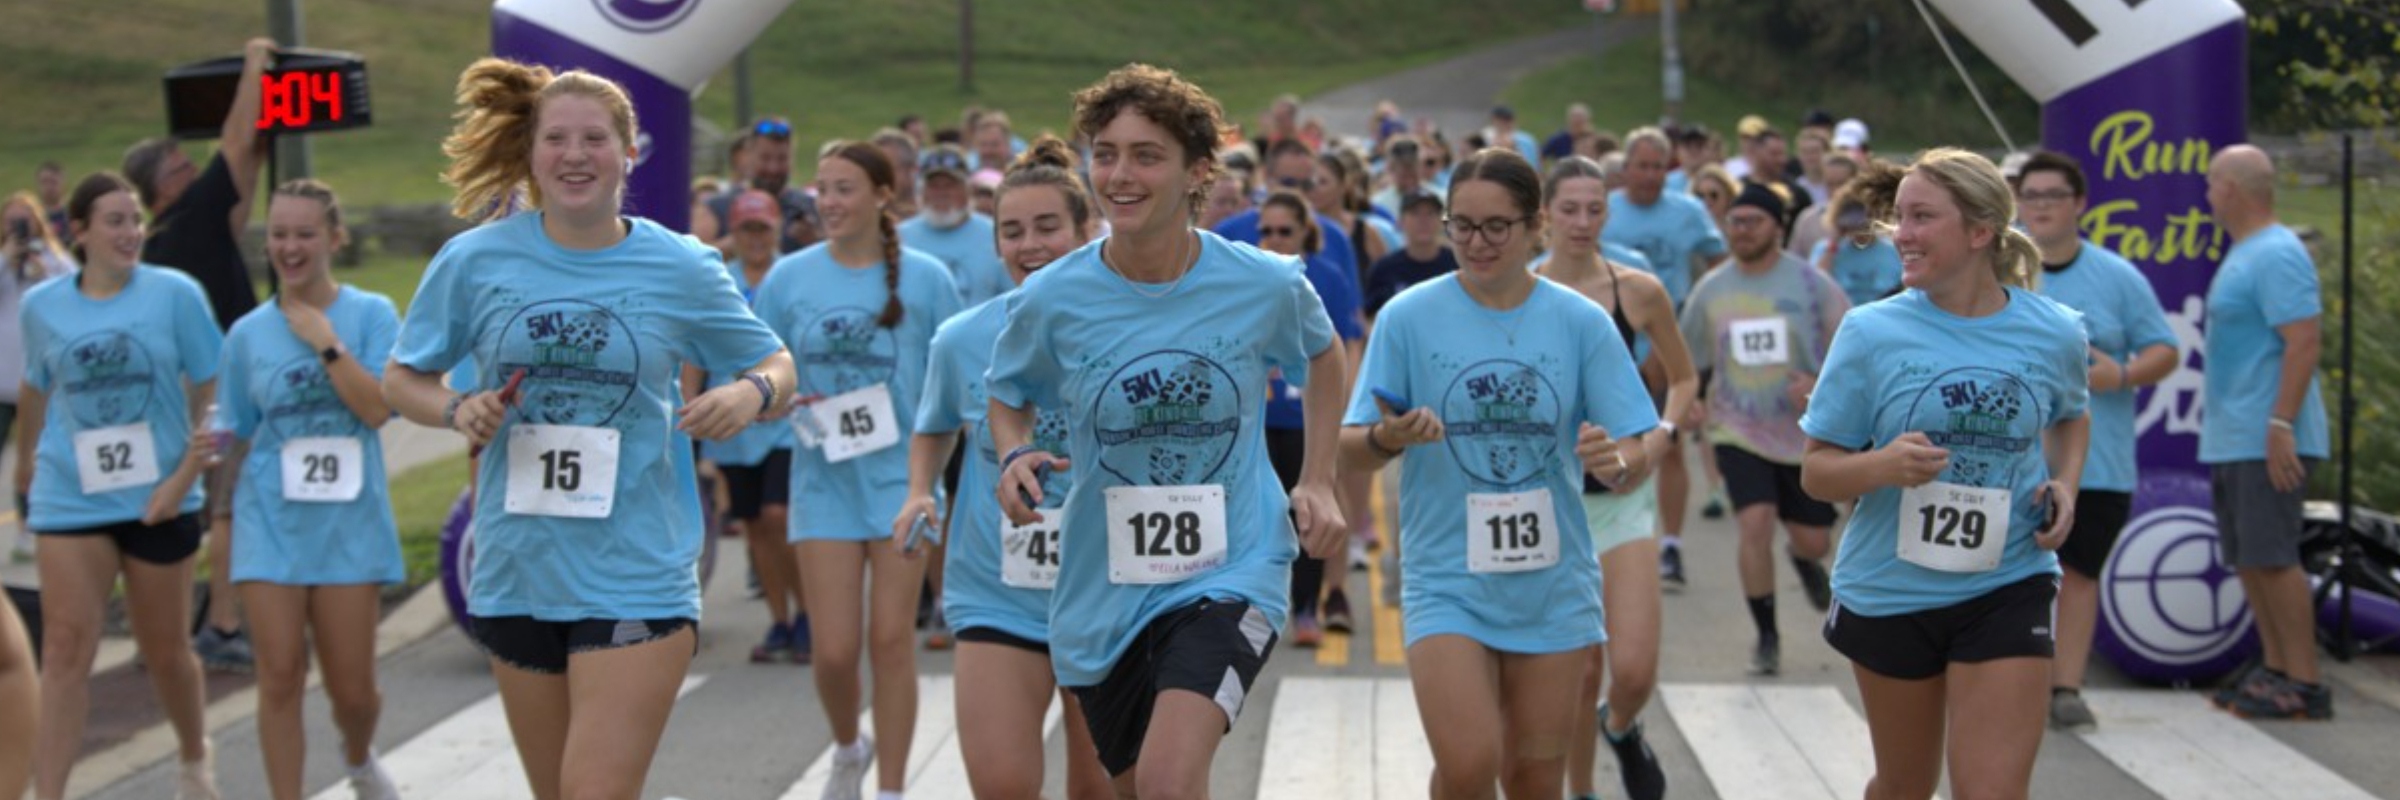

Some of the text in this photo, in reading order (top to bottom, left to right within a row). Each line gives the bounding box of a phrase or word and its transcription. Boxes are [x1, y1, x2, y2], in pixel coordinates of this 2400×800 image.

[2090, 110, 2210, 180] Run
[2079, 200, 2223, 263] Fast!
[527, 311, 563, 340] 5K!
[1741, 330, 1776, 353] 123
[1121, 368, 1162, 404] 5K!
[1466, 373, 1499, 400] 5K!
[1940, 380, 1977, 409] 5K!
[839, 405, 875, 439] 45
[97, 440, 134, 473] 52
[303, 454, 339, 484] 29
[539, 449, 581, 491] 15
[1127, 511, 1201, 556] 128
[1486, 511, 1540, 550] 113
[1919, 504, 1987, 550] 129
